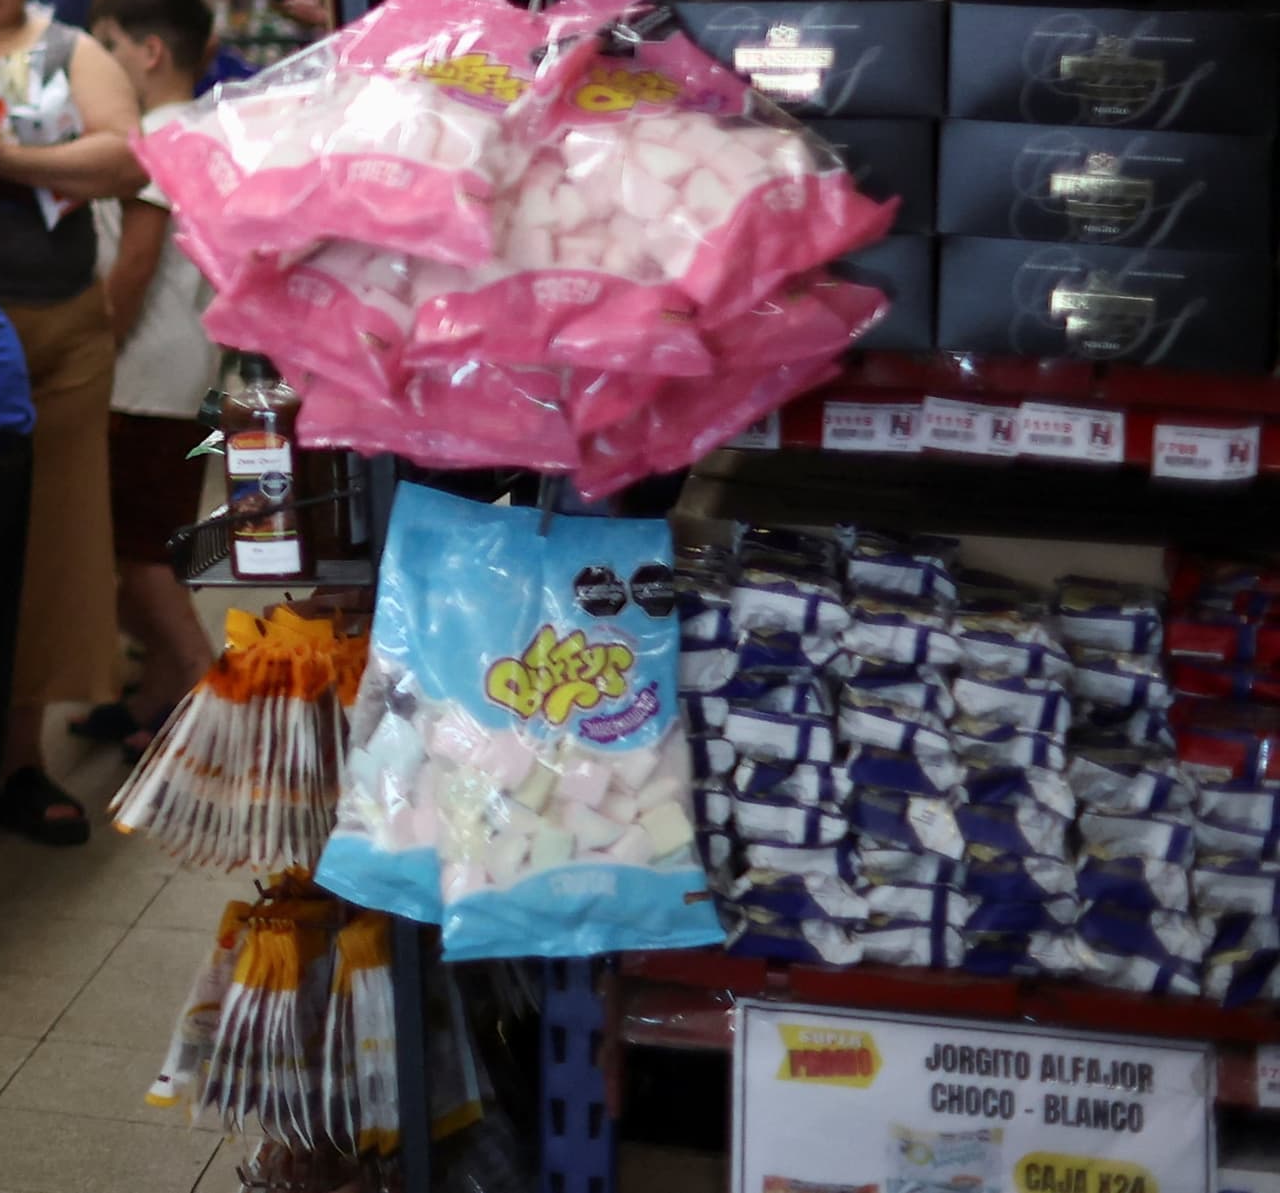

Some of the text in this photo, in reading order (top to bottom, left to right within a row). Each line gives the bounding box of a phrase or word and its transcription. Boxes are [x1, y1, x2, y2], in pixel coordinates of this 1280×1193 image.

[925, 1044, 1155, 1094] JORGITO ALFAJOR
[930, 1083, 1016, 1122] CHOCO
[1044, 1092, 1146, 1134] BLANCO
[1024, 1161, 1089, 1193] CAJA
